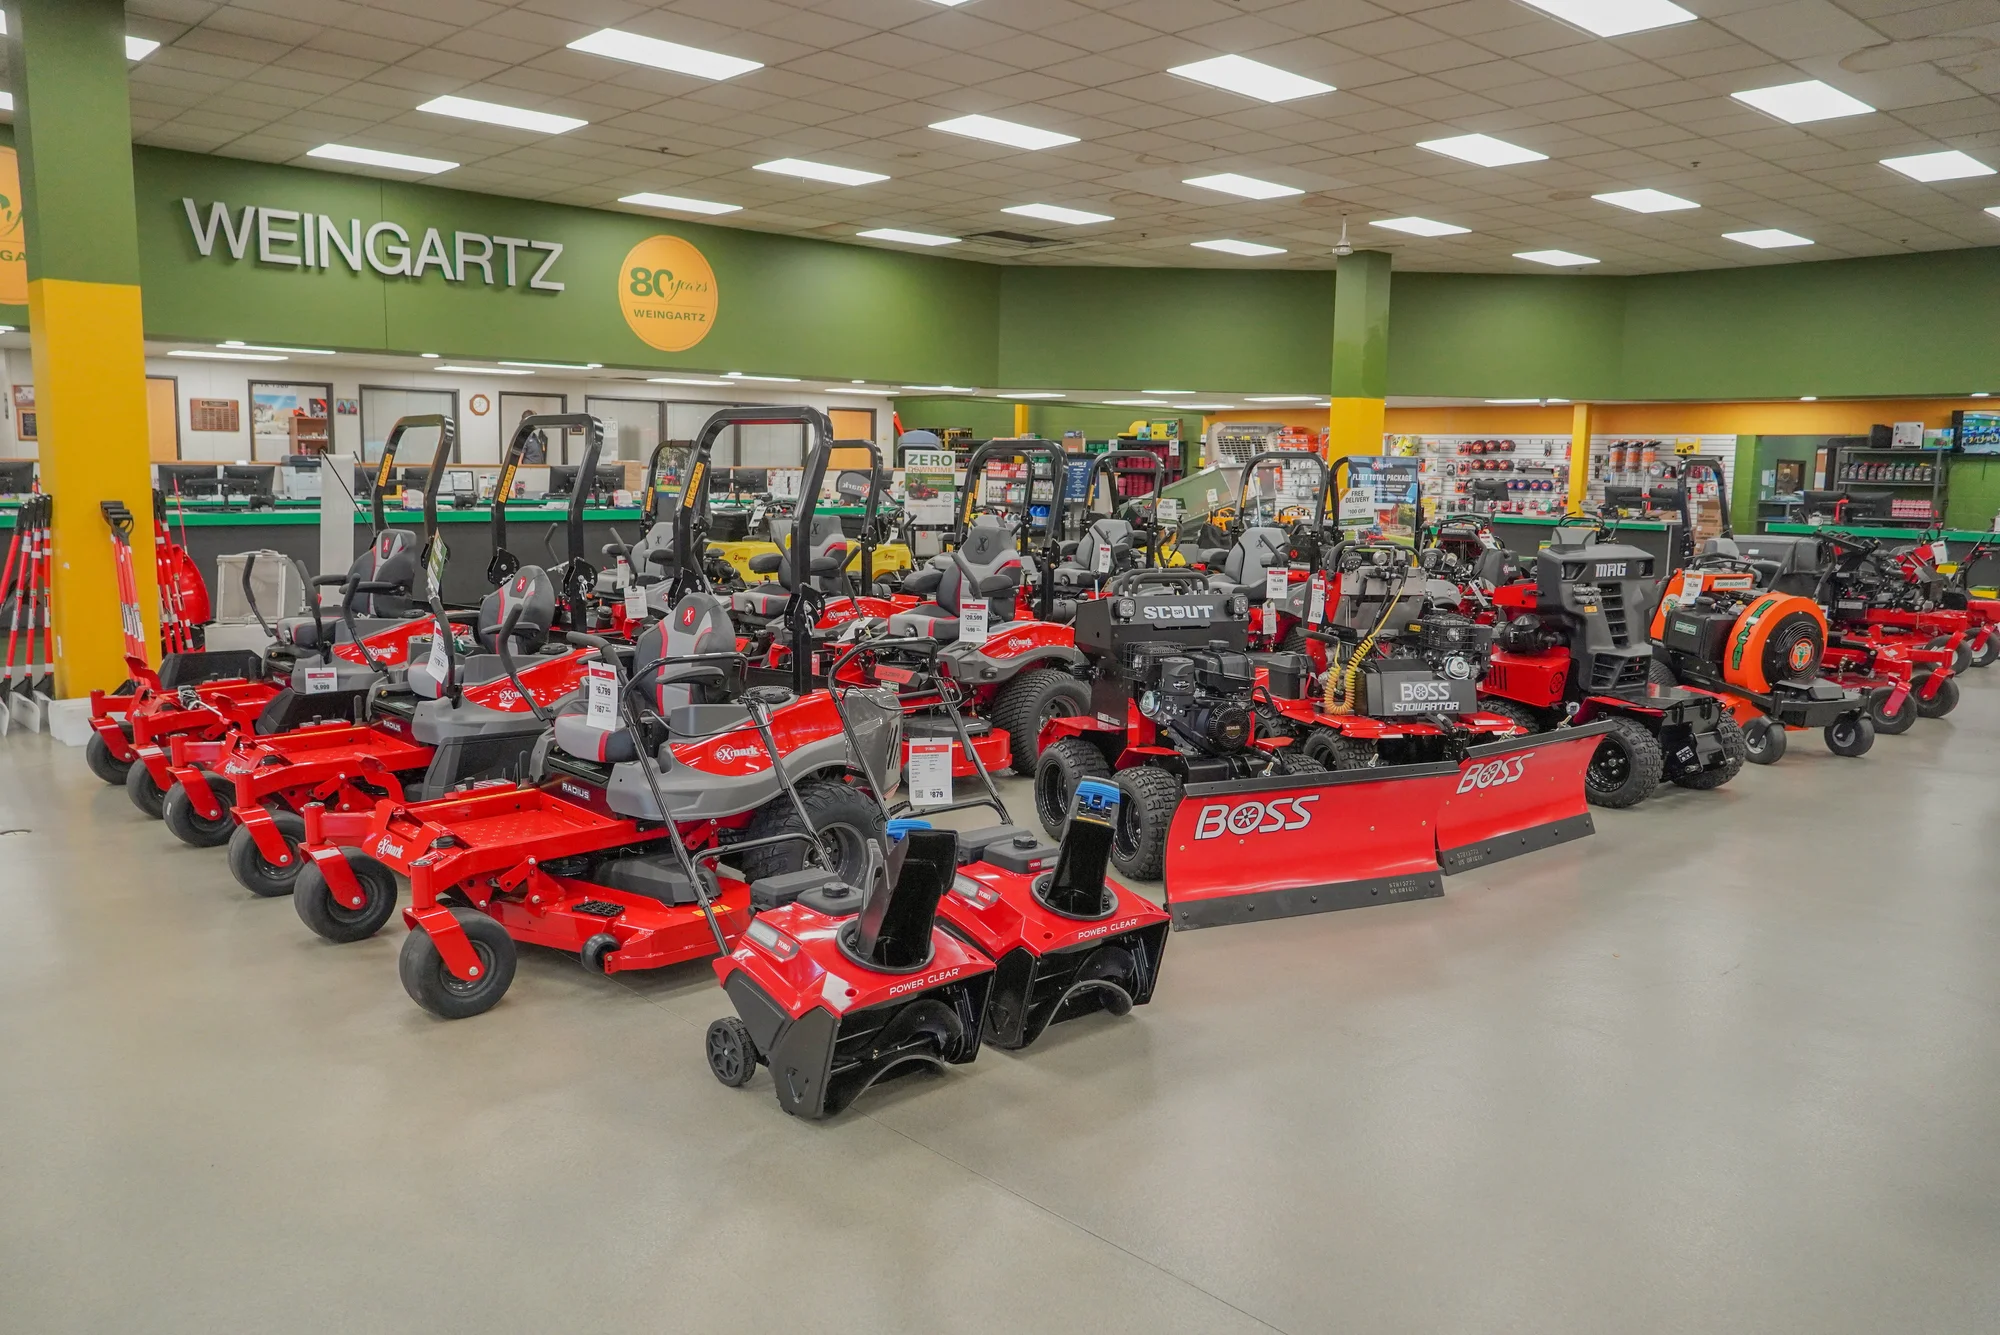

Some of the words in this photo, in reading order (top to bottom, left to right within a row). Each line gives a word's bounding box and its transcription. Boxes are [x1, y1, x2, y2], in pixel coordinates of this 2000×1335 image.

[182, 197, 565, 292] WEINGARTZ
[630, 267, 673, 298] 80
[634, 309, 706, 321] WEINGARTZ
[908, 454, 953, 466] ZERO
[1352, 473, 1368, 481] FLEET
[1369, 473, 1385, 481] TOTAL
[1595, 563, 1627, 577] MAG
[1143, 605, 1214, 619] SCOUT
[1401, 682, 1450, 700] BOSS
[1393, 702, 1460, 712] SNOWRATOR
[383, 719, 402, 733] RADIUS
[1456, 752, 1535, 794] BOSS
[562, 782, 590, 799] RADIUS
[1194, 794, 1320, 840] BOSS
[1077, 926, 1108, 940] POWER
[1110, 918, 1138, 931] CLEAR
[778, 939, 791, 952] TORO
[889, 979, 924, 996] POWER
[928, 968, 959, 984] CLEAR
